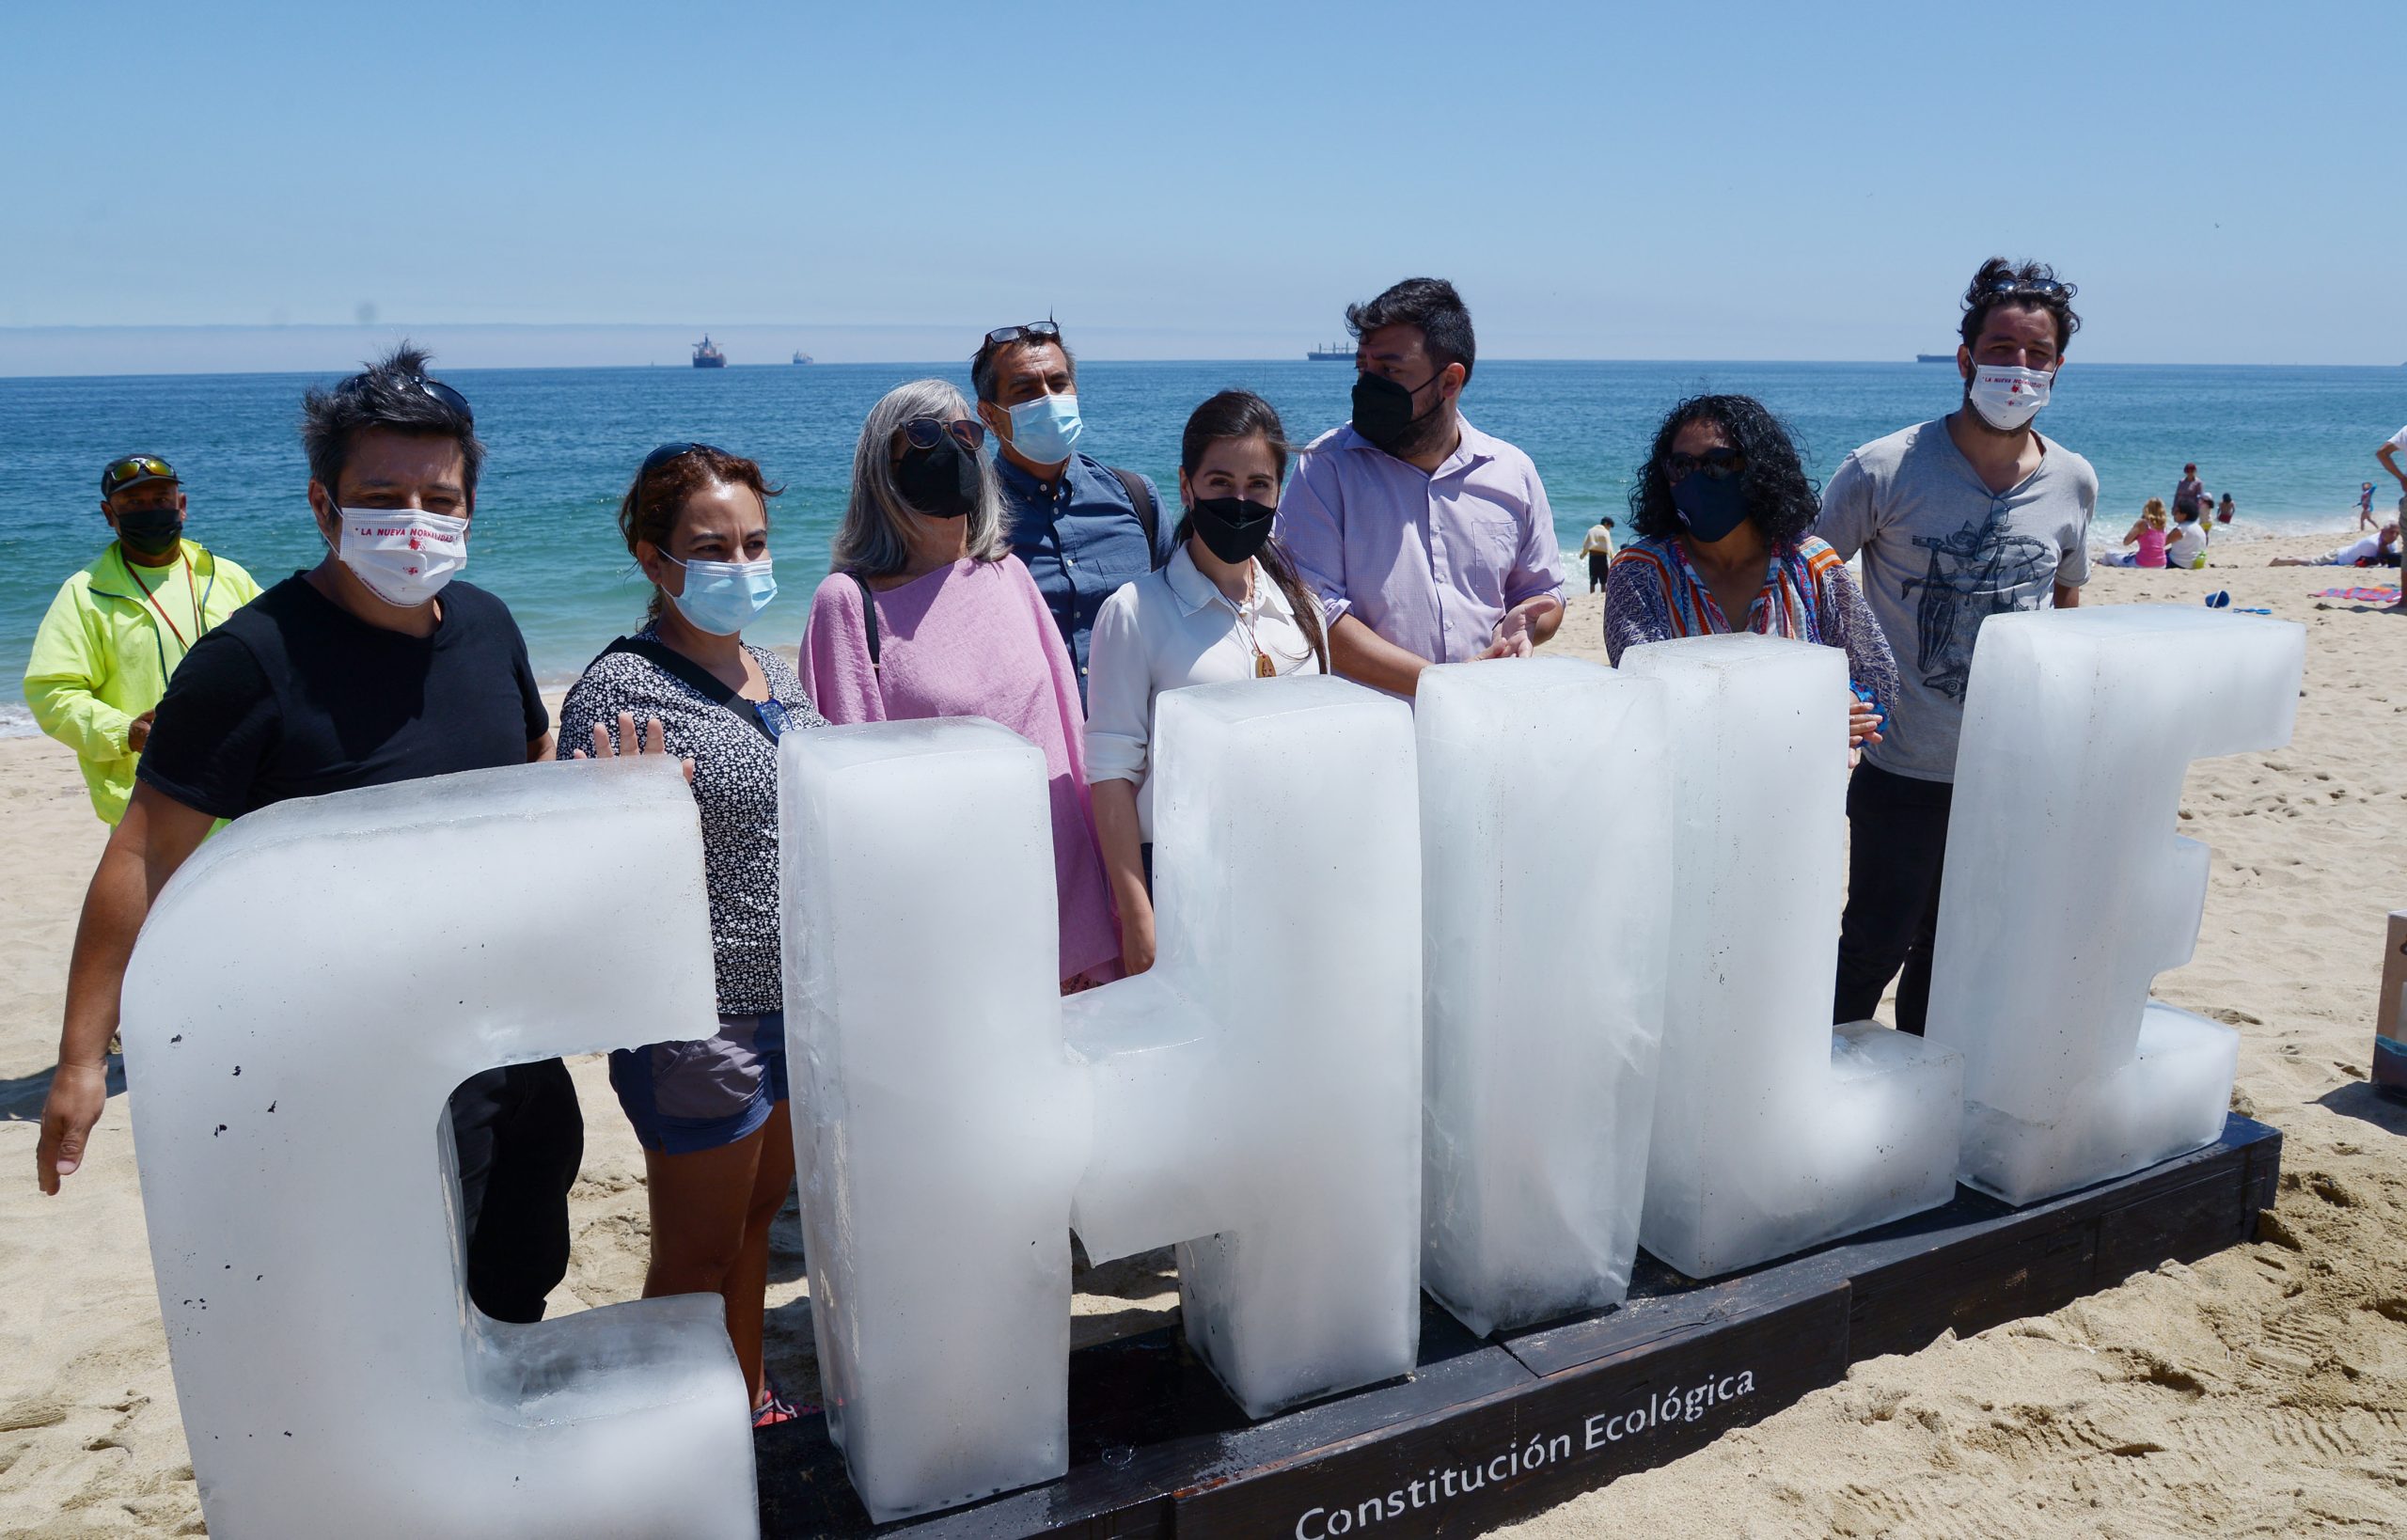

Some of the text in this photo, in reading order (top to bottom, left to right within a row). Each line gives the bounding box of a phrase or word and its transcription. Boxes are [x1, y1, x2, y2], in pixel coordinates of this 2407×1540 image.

[120, 604, 2304, 1540] CHILE
[1297, 1370, 1754, 1540] Constitución Ecológica
